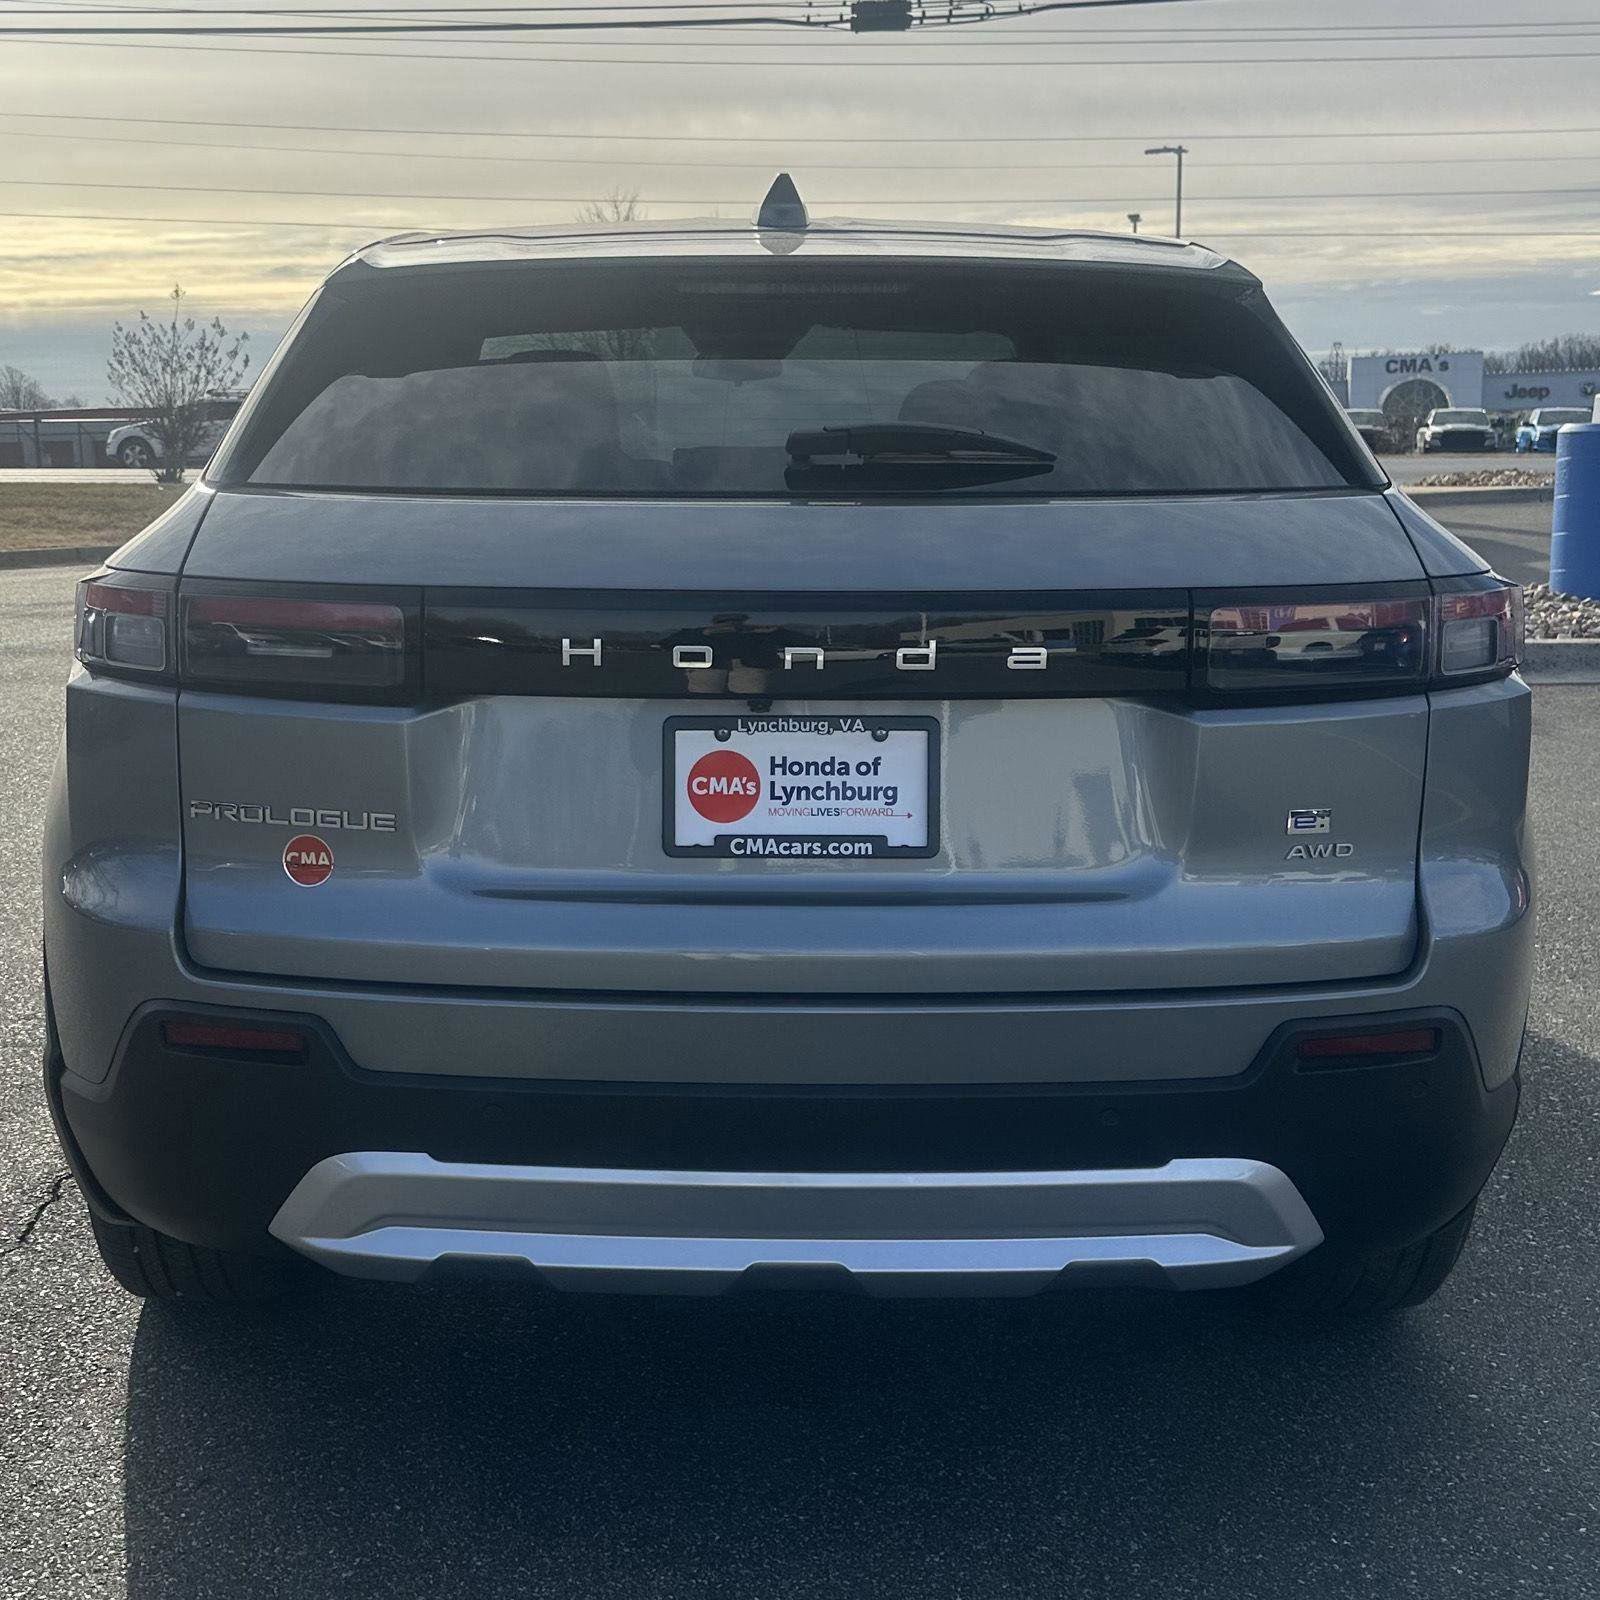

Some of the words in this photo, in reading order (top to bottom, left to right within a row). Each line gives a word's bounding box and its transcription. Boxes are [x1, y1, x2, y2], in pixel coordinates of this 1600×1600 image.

[1385, 356, 1449, 374] CMA's
[1504, 384, 1550, 400] Jeep
[561, 638, 1047, 671] Honda
[737, 718, 834, 734] Lynchburg,
[839, 718, 865, 732] VA
[769, 756, 852, 776] Honda
[855, 756, 881, 776] of
[691, 777, 757, 796] CMA's
[769, 781, 898, 805] Lynchburg
[190, 800, 397, 832] PROLOGUE
[730, 838, 873, 855] CMAcars.com
[1285, 843, 1354, 860] AWD
[286, 851, 331, 867] CMA
